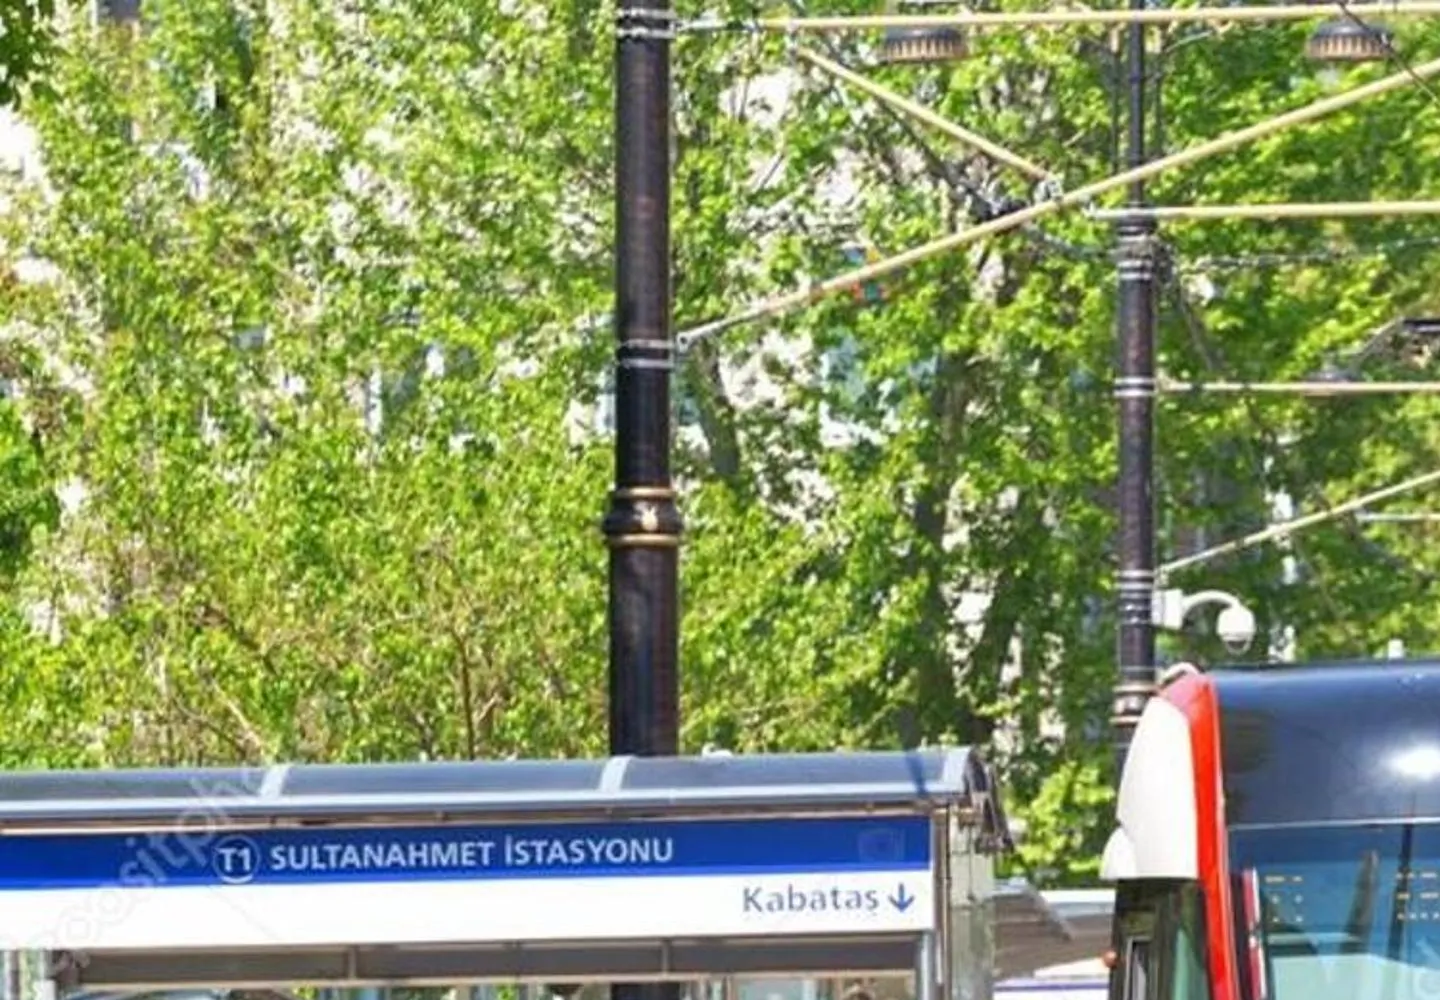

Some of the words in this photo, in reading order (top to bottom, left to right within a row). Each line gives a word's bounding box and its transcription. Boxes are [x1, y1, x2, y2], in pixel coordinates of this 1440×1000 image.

[218, 847, 250, 871] T1
[270, 842, 495, 871] SULTANAHMET
[505, 837, 675, 866] İSTASYONU
[742, 884, 880, 915] Kabataş
